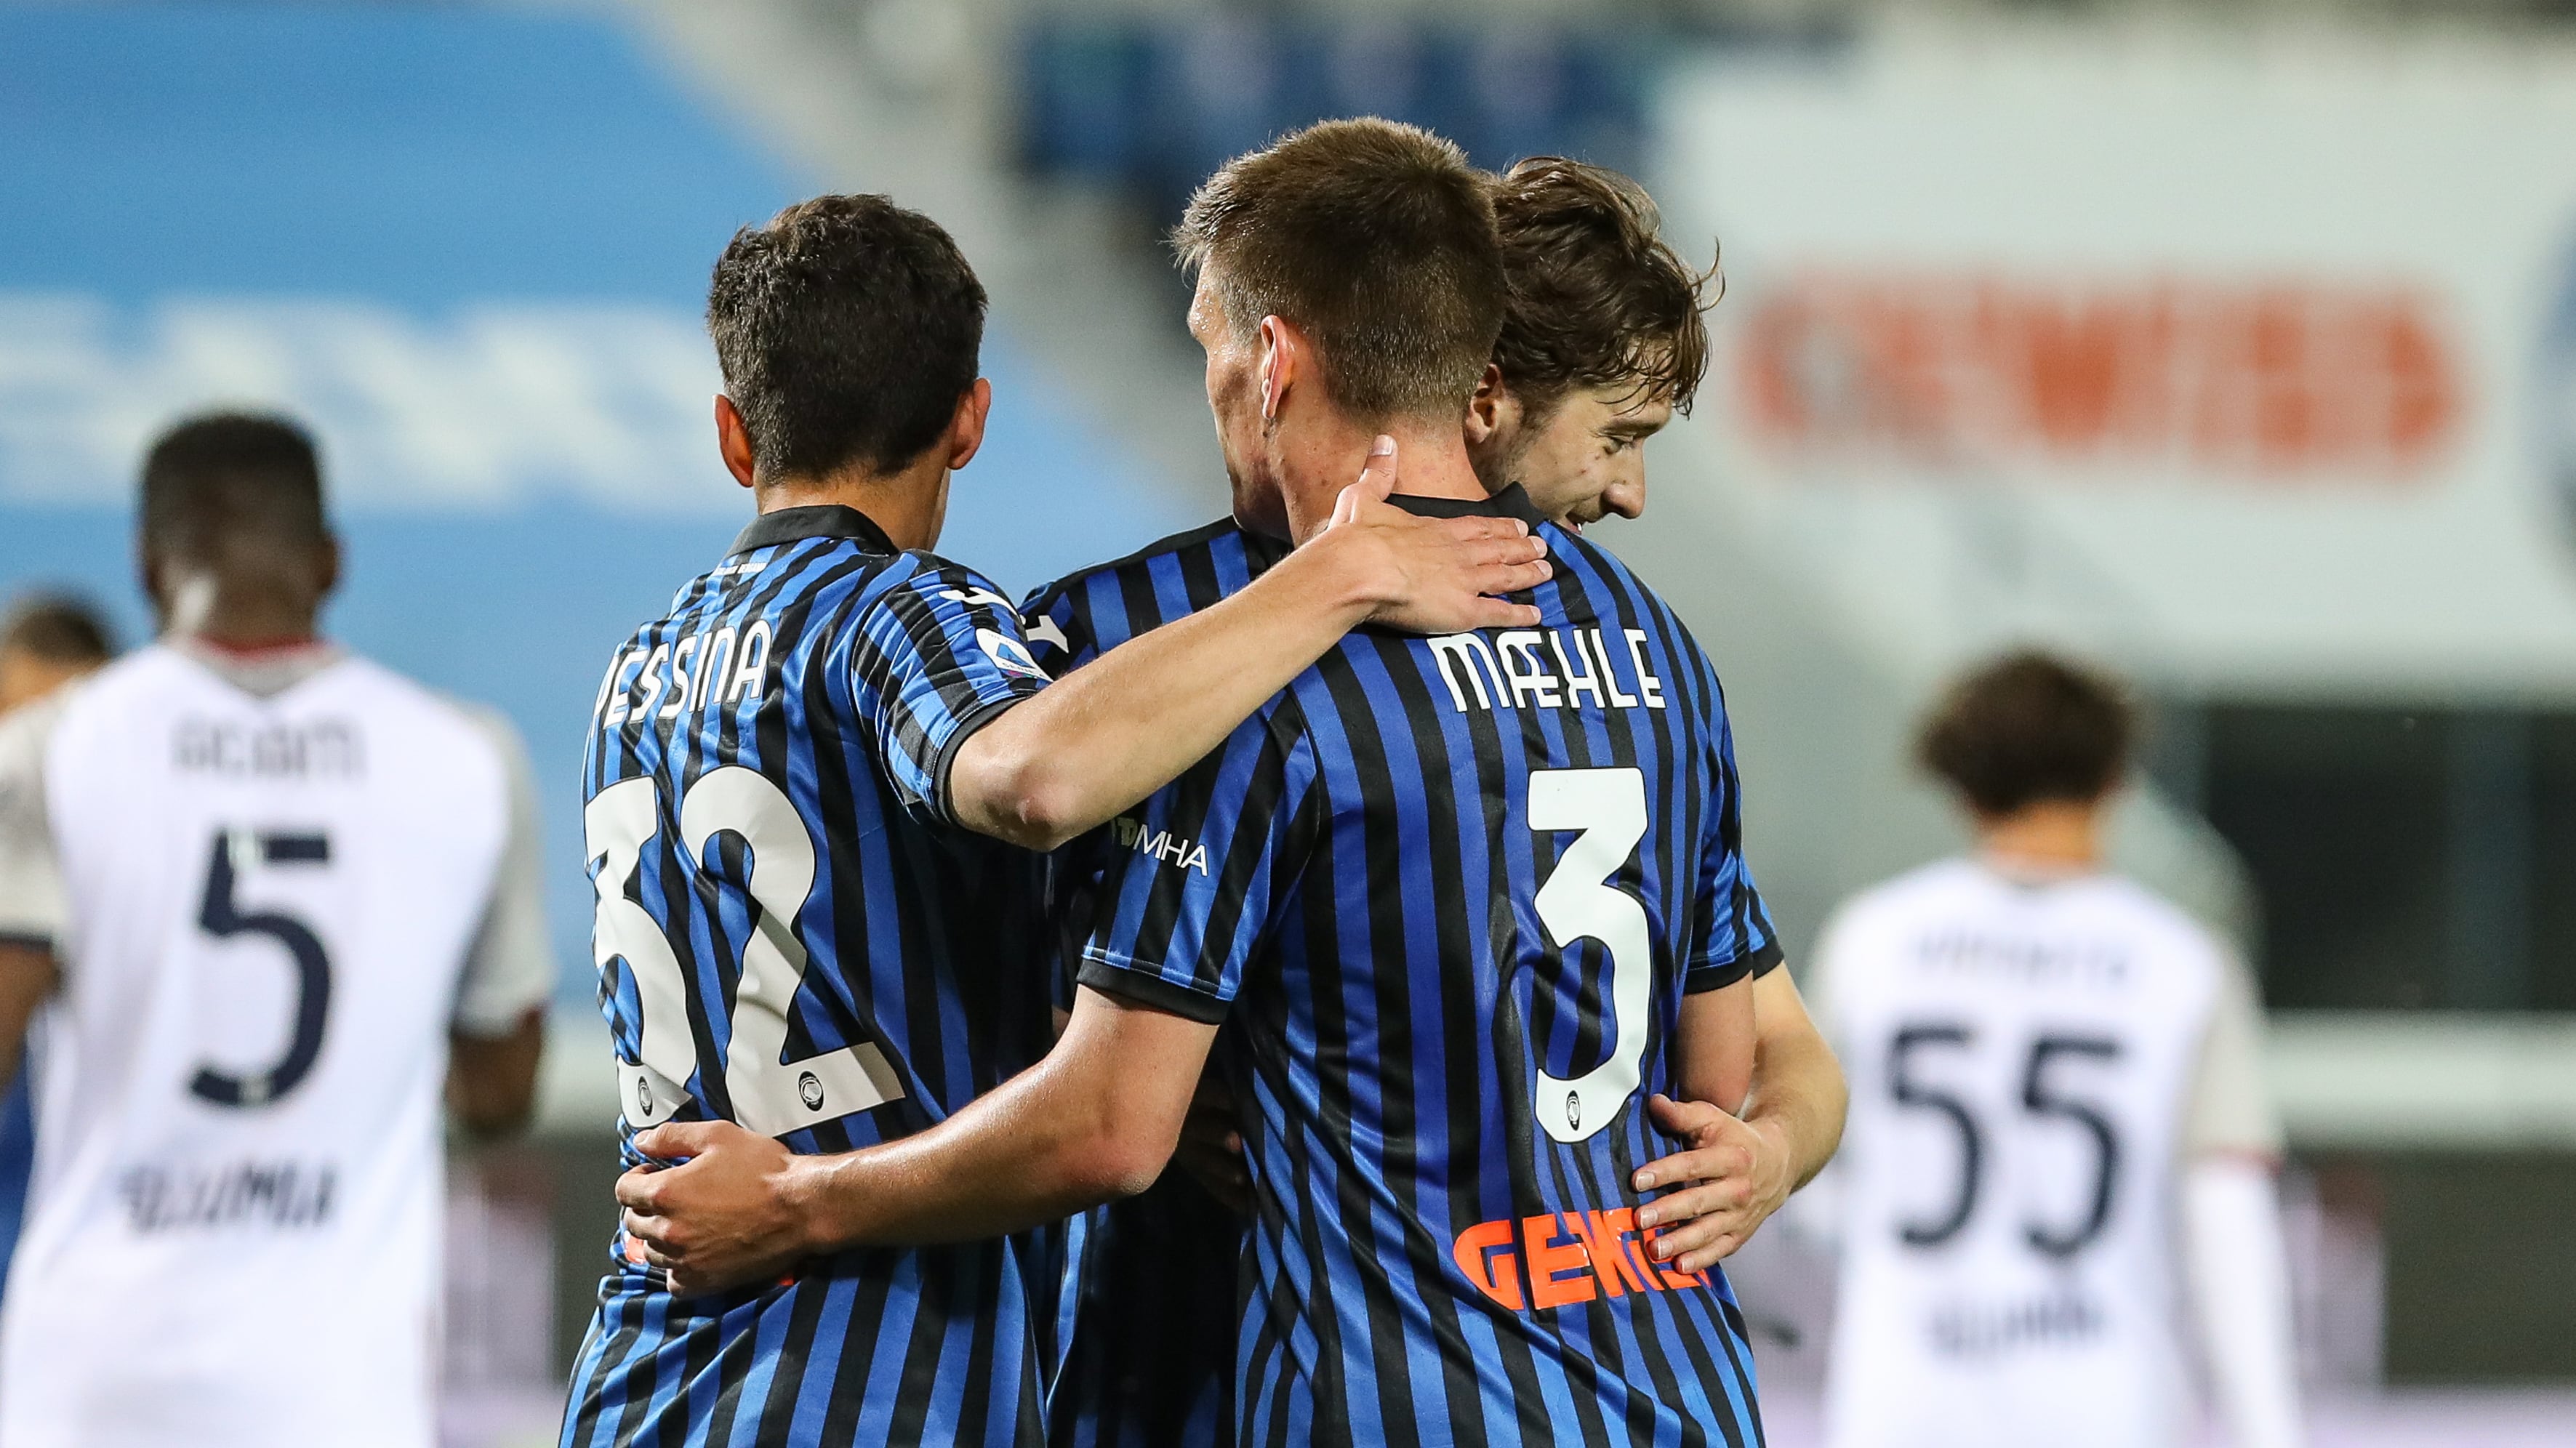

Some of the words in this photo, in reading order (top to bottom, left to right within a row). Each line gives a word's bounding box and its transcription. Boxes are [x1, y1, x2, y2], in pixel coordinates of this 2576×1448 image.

[1427, 629, 1666, 712] MÆHLE
[190, 831, 332, 1108] 5
[585, 765, 905, 1138] 32
[1528, 768, 1650, 1143] 3
[1453, 1207, 1712, 1311] GEWI
[1886, 1022, 2123, 1262] 55
